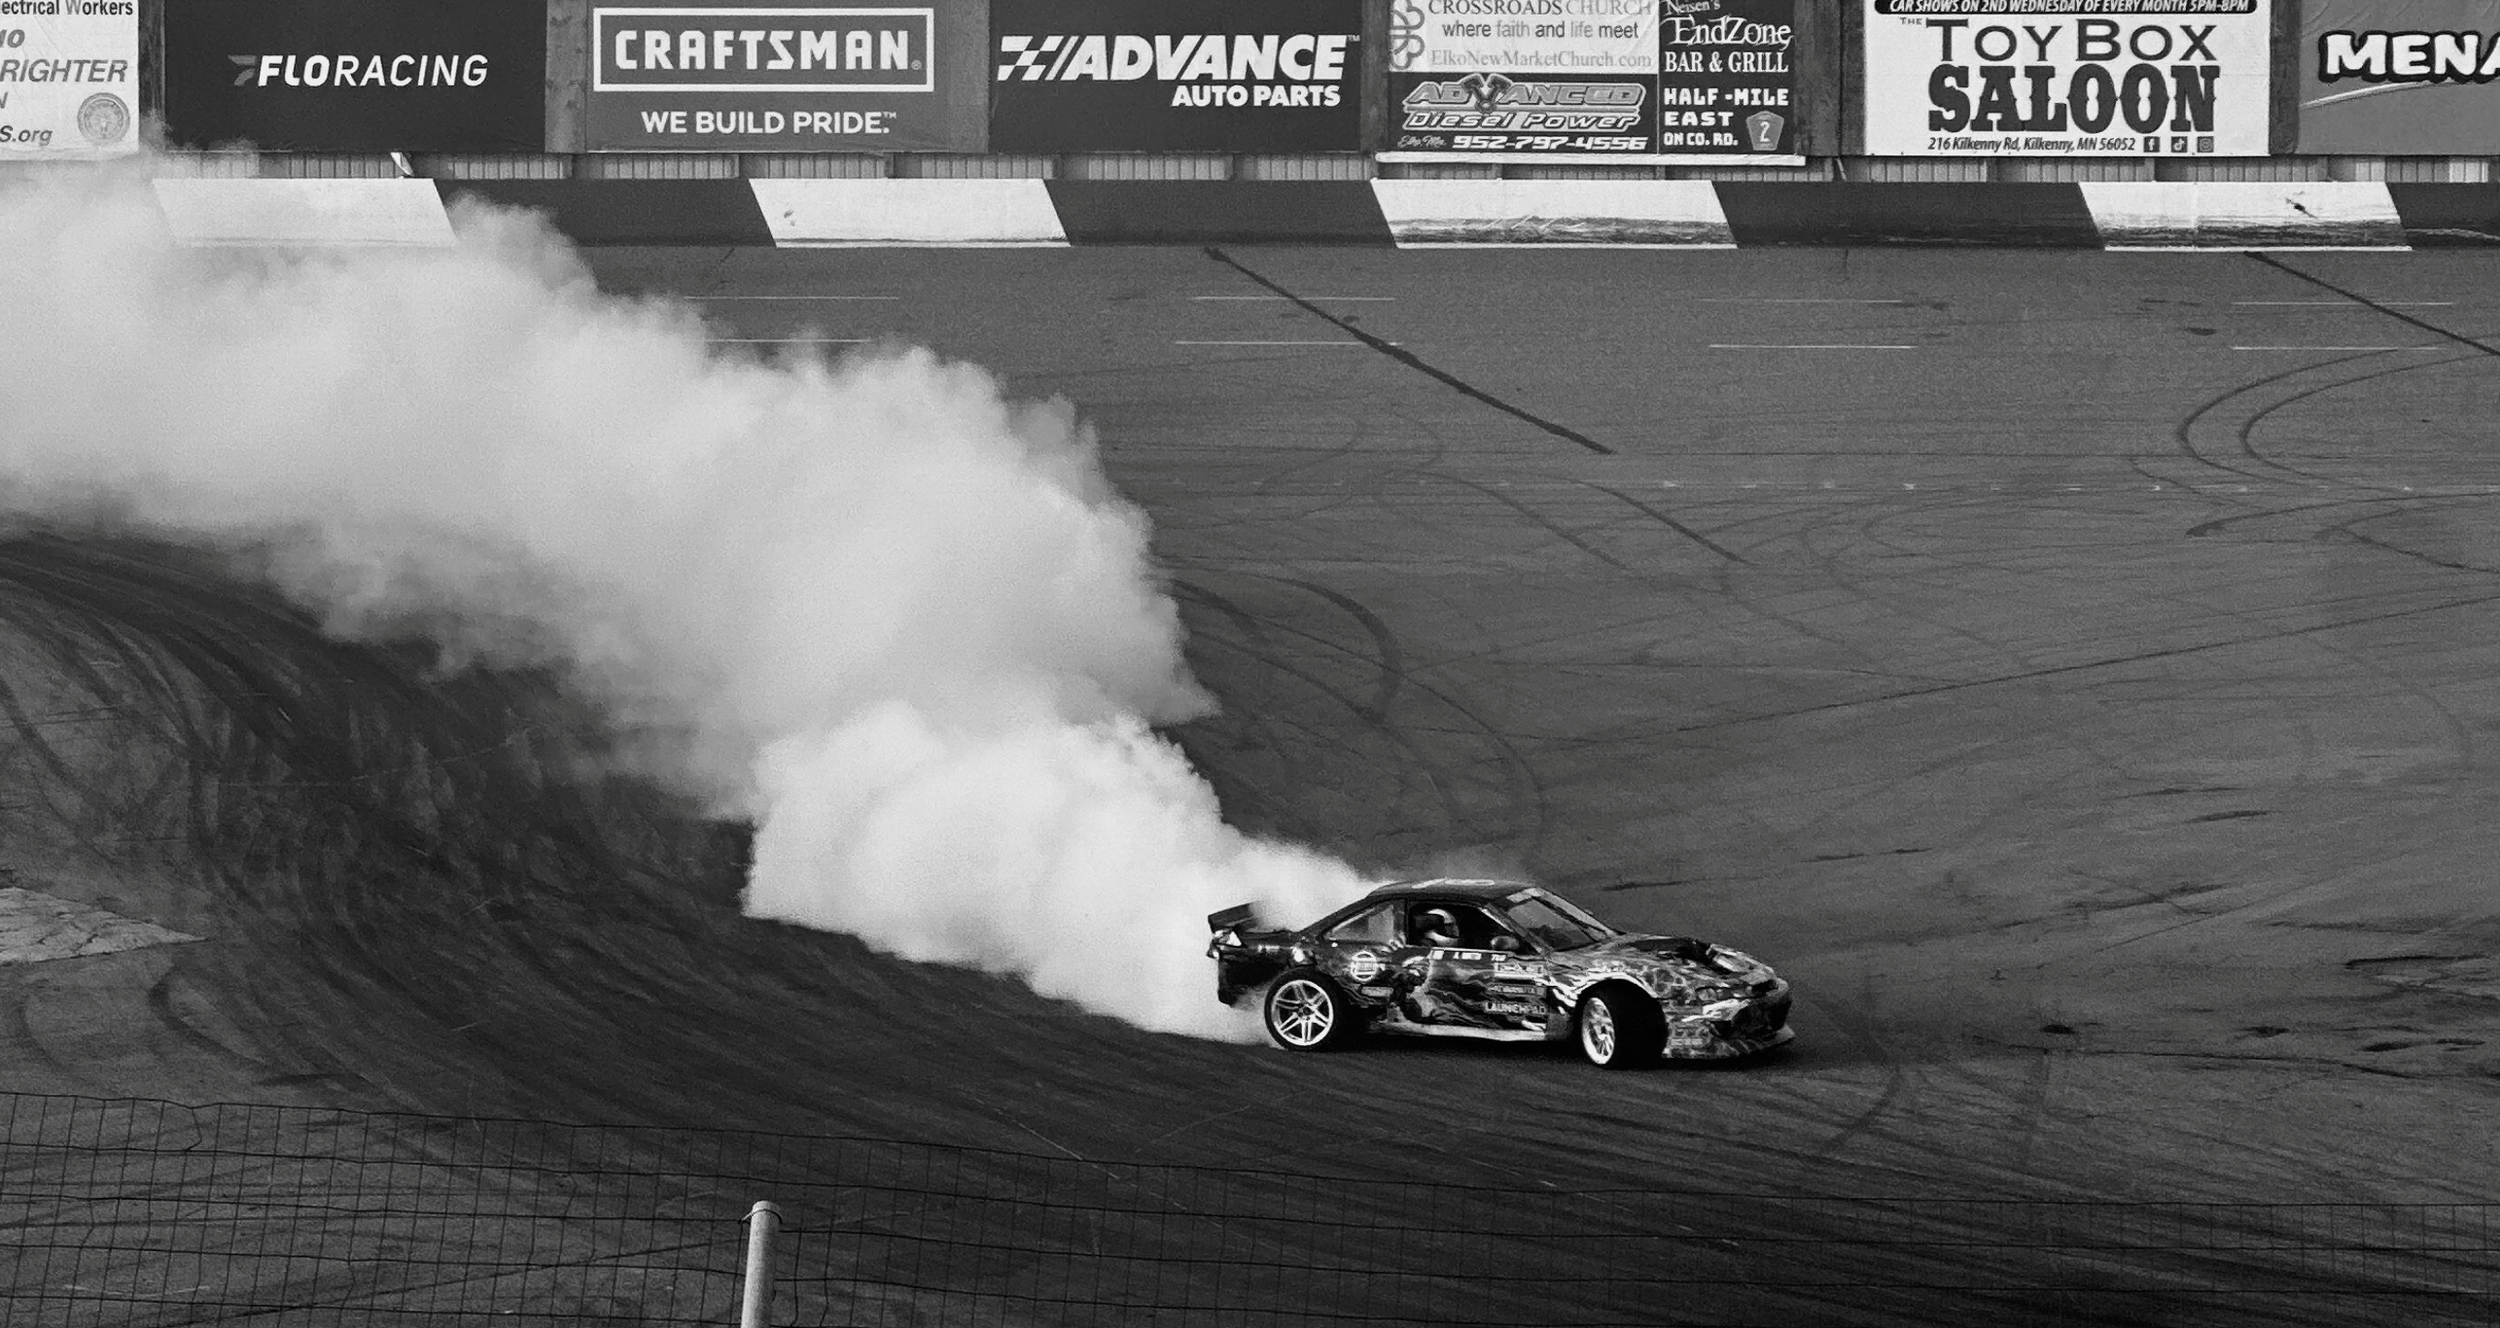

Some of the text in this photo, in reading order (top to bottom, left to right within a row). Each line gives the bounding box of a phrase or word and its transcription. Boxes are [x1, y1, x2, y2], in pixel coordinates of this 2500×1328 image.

[65, 0, 133, 15] Workers
[1428, 0, 1651, 15] CROSSROADS CHURCH
[1960, 0, 1979, 13] ON
[2009, 0, 2082, 13] WEDNESDAY
[2083, 0, 2101, 13] OF
[2102, 0, 2139, 12] EVERY
[2142, 0, 2187, 12] MONTH
[1442, 20, 1639, 38] where faith and life meet
[1901, 17, 1922, 25] THE
[1660, 14, 1794, 51] EndZone
[1431, 50, 1652, 67] ElkoNewMarketChurch.com
[1664, 51, 1789, 73] BAR & GRILL
[1171, 85, 1341, 107] AUTO PARTS
[1928, 63, 2221, 134] SALOON
[640, 111, 688, 134] WE
[695, 111, 786, 134] BUILD
[1407, 112, 1636, 129] Diesel Power
[1664, 111, 1734, 126] EAST
[1663, 132, 1739, 146] ON CO. RD.
[1759, 121, 1771, 142] 2
[1452, 136, 1648, 149] 952-797-4556
[1927, 137, 2136, 154] 216 Kilkenny Rd, Kilkenny, MN 56052
